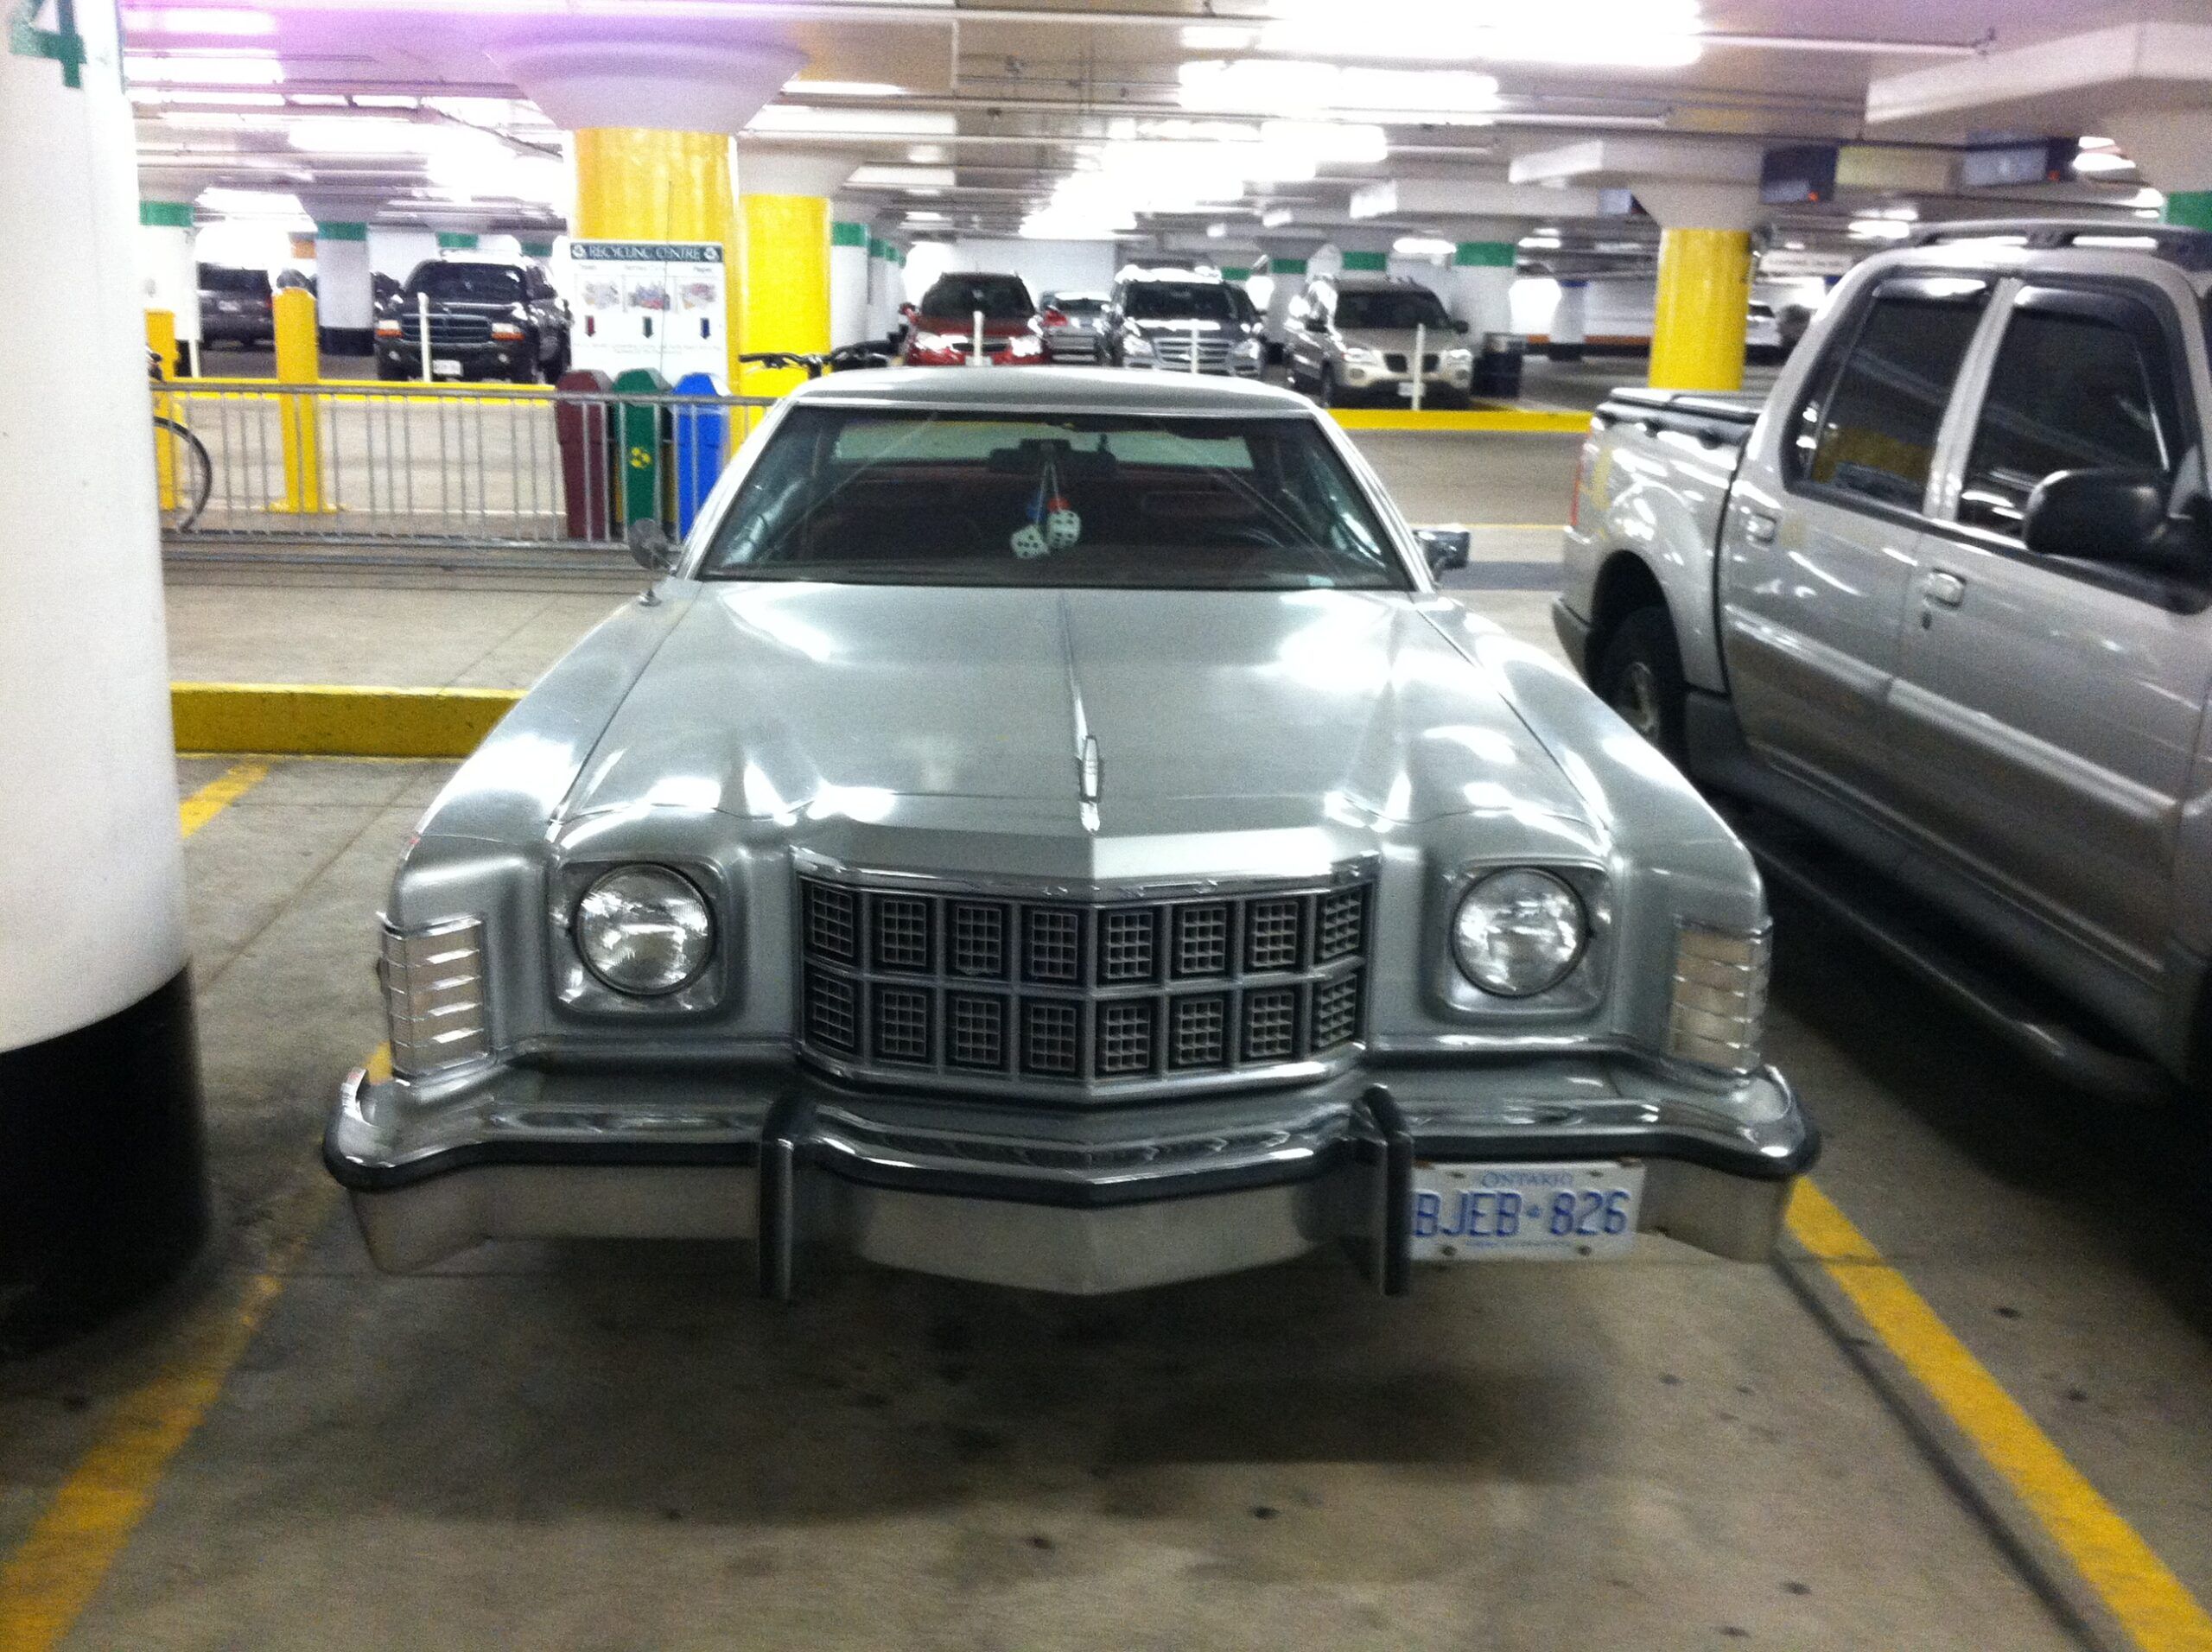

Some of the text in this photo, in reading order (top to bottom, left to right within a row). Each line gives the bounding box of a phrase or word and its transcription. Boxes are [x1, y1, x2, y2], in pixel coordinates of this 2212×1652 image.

[589, 245, 701, 261] RECYCLING CENTRE
[1481, 1171, 1574, 1188] ONTARIO
[1414, 1189, 1630, 1236] BJEB 826
